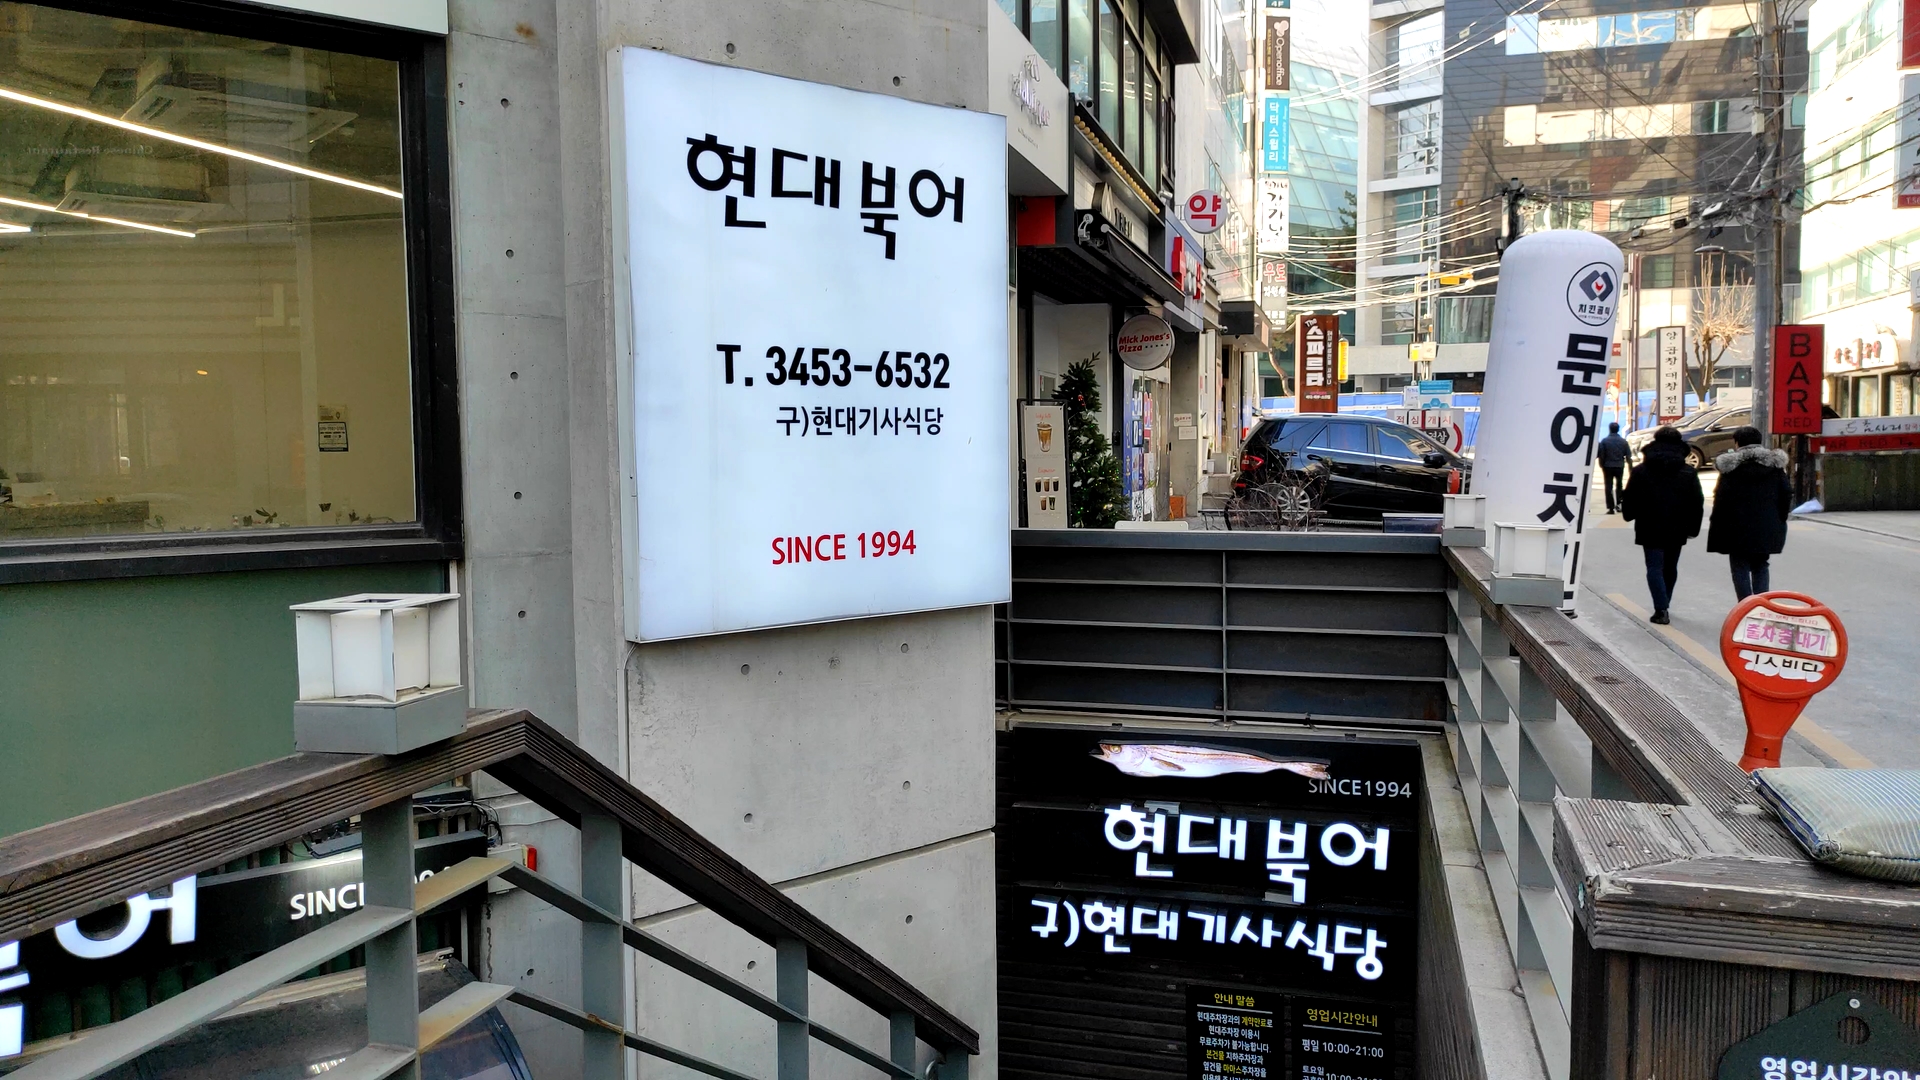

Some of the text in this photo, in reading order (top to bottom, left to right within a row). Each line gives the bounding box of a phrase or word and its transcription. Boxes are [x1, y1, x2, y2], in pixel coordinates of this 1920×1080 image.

[1275, 37, 1285, 86] Openoffice
[1189, 194, 1222, 227] 약
[1263, 261, 1287, 284] 우도
[1304, 318, 1318, 328] The
[1118, 332, 1170, 345] Mick Jones's
[1118, 345, 1143, 353] Pizza
[1305, 325, 1325, 387] 스파르타
[716, 343, 951, 390] T. 3453-6532
[1786, 333, 1812, 413] BAR
[1664, 395, 1679, 414] 전문
[776, 405, 945, 438] 구)현대기사식당
[1783, 417, 1812, 428] RED
[772, 529, 917, 565] SINCE 1994
[1746, 623, 1776, 643] 출차
[1796, 630, 1826, 651] 대기
[1030, 898, 1388, 981] 구)현대기사식당
[1214, 993, 1255, 1007] 안내 말씀
[1196, 1011, 1241, 1025] 현대주차장과의
[1306, 1008, 1378, 1028] 영업시간안내
[1208, 1024, 1260, 1040] 현대주차장 이용시
[1199, 1036, 1231, 1049] 무료주차가
[1302, 1038, 1384, 1058] 평일 10:00~21:00
[1206, 1049, 1264, 1065] 본건물 지하주차장과
[1302, 1065, 1325, 1076] 토요일
